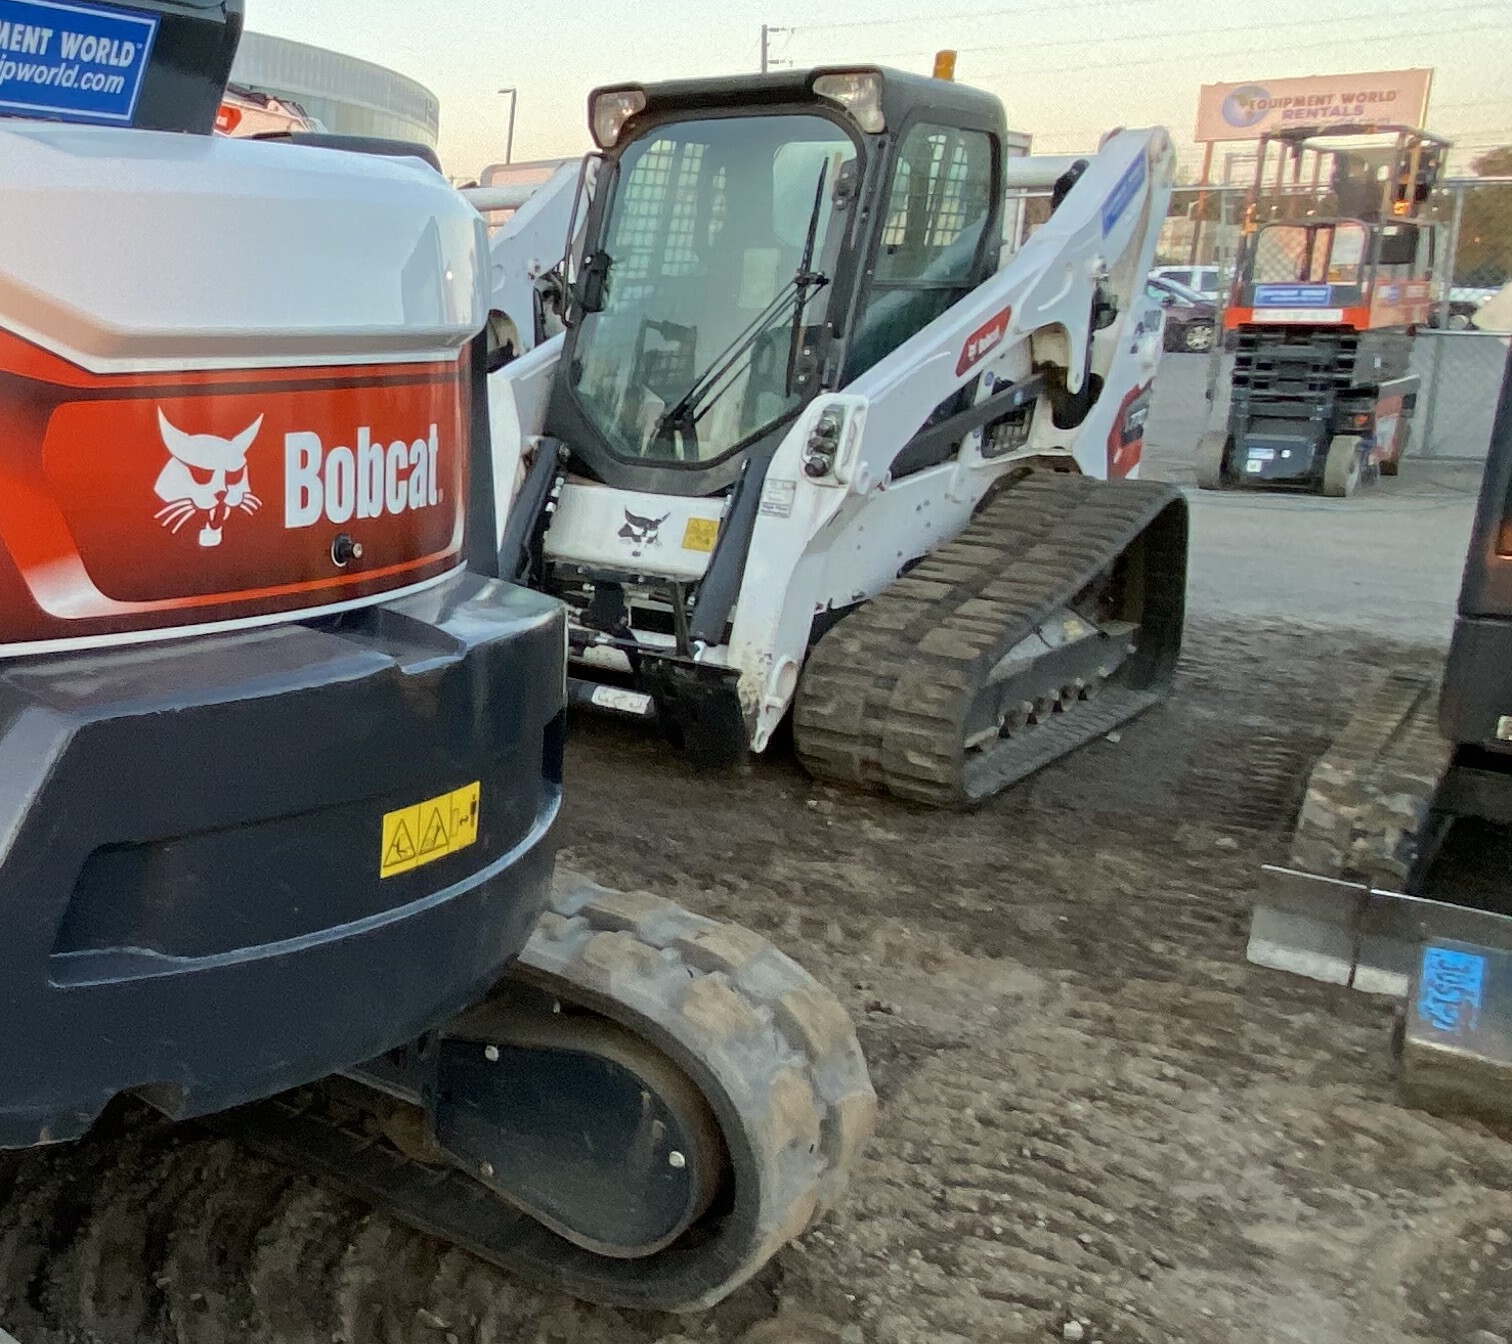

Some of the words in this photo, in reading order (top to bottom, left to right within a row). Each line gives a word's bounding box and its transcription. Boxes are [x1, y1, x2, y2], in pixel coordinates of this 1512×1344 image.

[60, 31, 136, 68] WORLD
[1249, 93, 1335, 110] EQUIPMENT
[1341, 90, 1397, 103] WORLD
[1281, 104, 1365, 121] RENTALS
[285, 424, 439, 528] Bobcat
